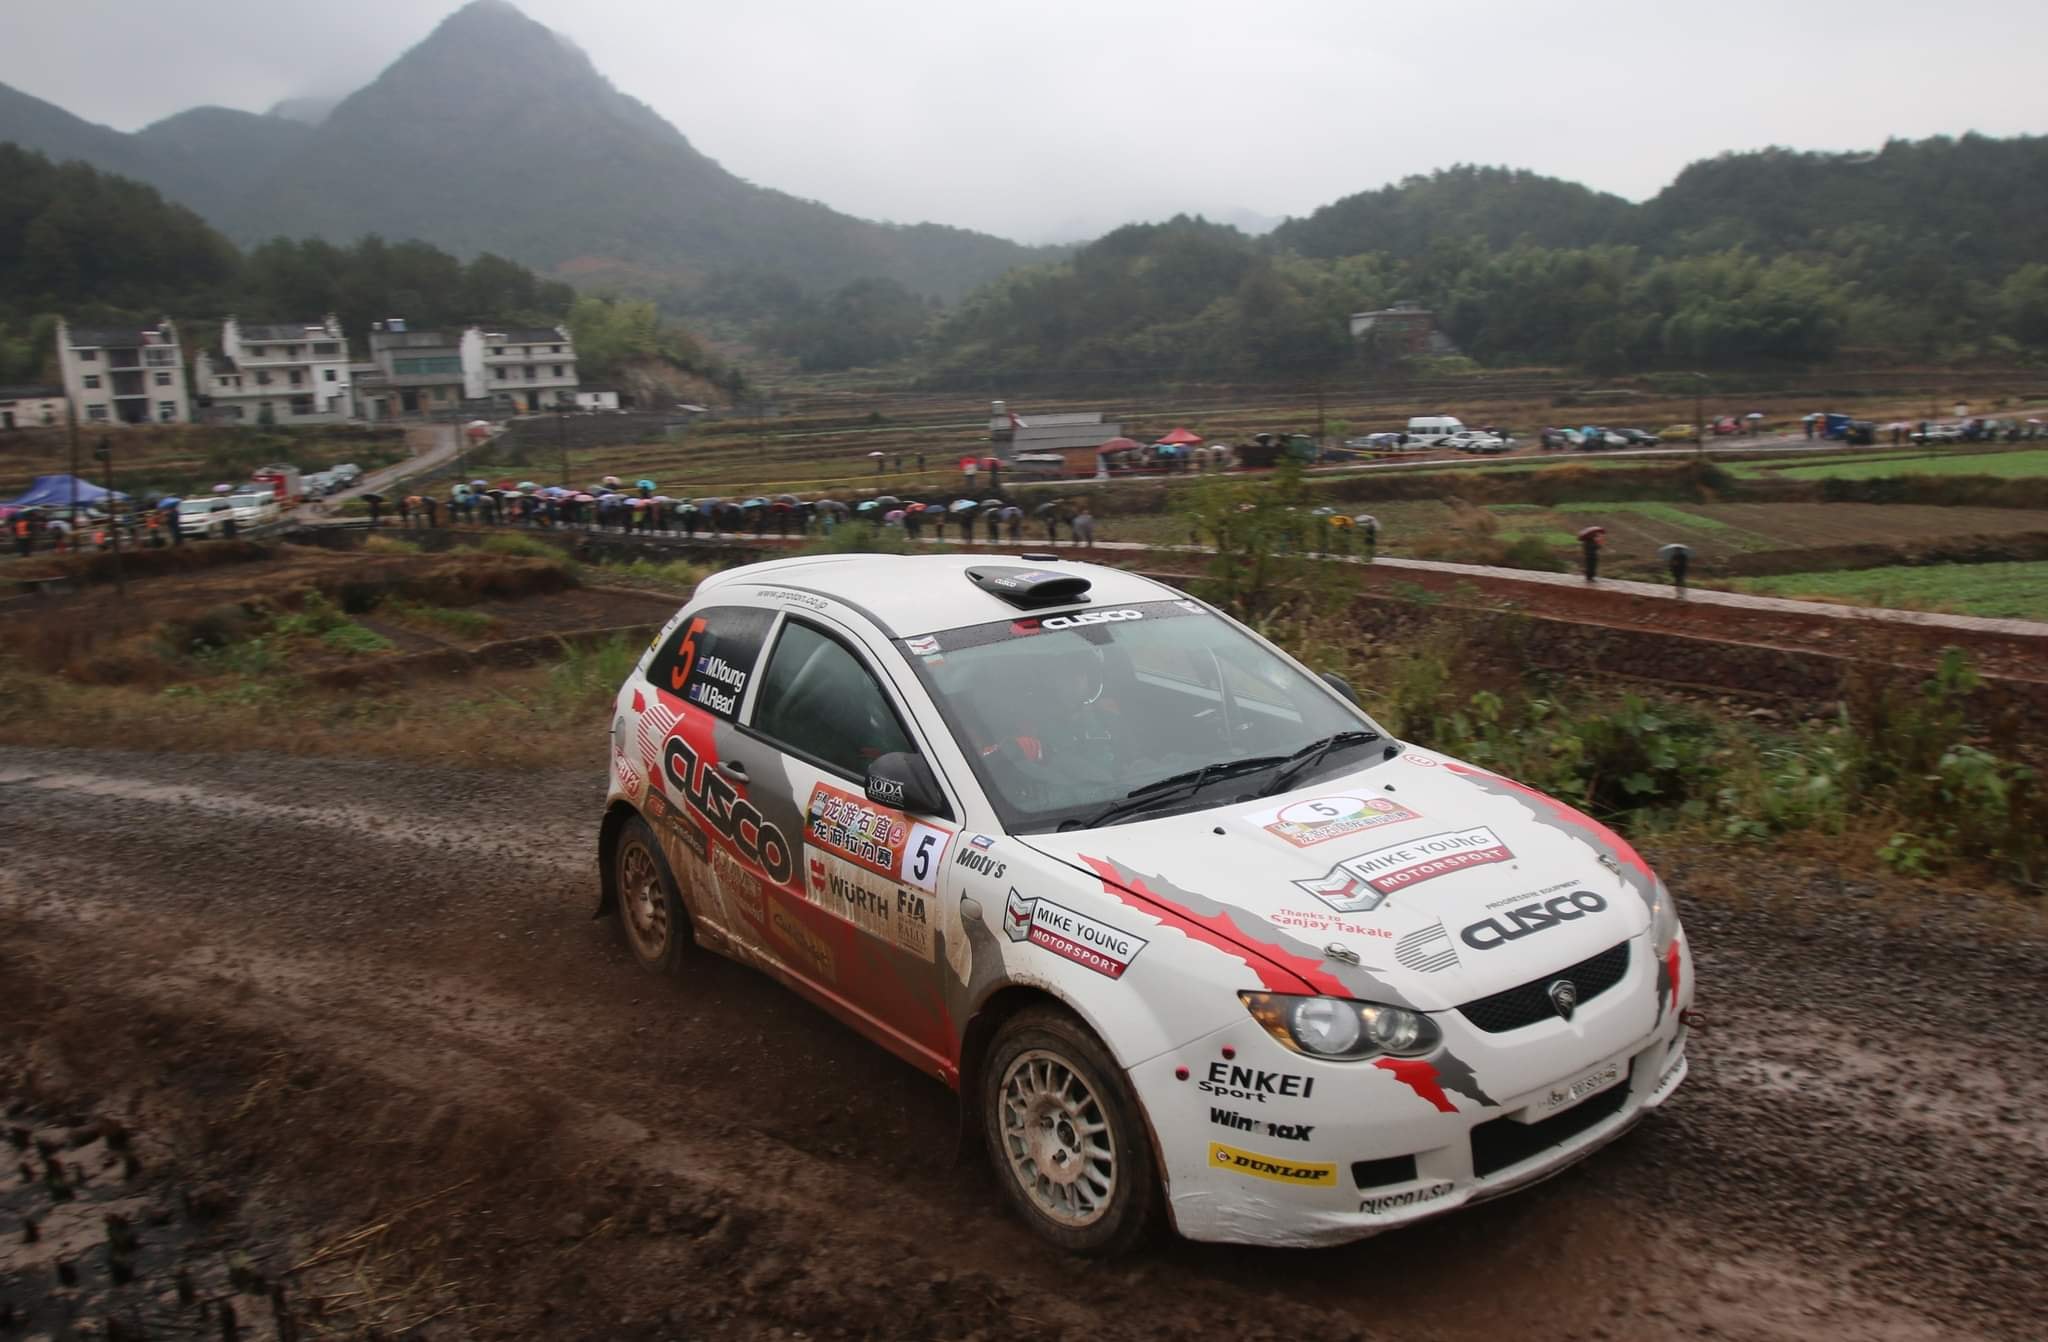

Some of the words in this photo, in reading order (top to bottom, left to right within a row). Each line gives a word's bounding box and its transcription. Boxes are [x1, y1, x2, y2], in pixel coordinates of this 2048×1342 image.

[1042, 609, 1144, 630] CUSCO
[671, 617, 708, 690] 5
[705, 656, 747, 693] M.Young
[698, 682, 736, 715] M.Read
[869, 775, 904, 798] YODA
[664, 735, 793, 884] CUSCO
[825, 798, 891, 842] 龙游石窟
[1309, 802, 1339, 816] 5
[814, 820, 893, 869] 龙游拉力赛
[914, 835, 936, 881] 5
[956, 847, 1007, 879] Moty's
[1356, 850, 1416, 874] MIKE
[1415, 834, 1489, 855] YOUNG
[1379, 849, 1504, 887] MOTORSPORT
[1037, 905, 1071, 932] MIKE
[1077, 924, 1129, 956] YOUNG
[1270, 914, 1329, 931] Sanjay
[1335, 921, 1393, 939] Takale
[1280, 908, 1325, 920] Thanks
[1460, 890, 1608, 950] CUSCO
[1033, 929, 1119, 973] MOTORSPORT
[1198, 1080, 1267, 1103] Sport
[1208, 1061, 1315, 1098] ENKEI
[1233, 1155, 1330, 1180] DUNLOP
